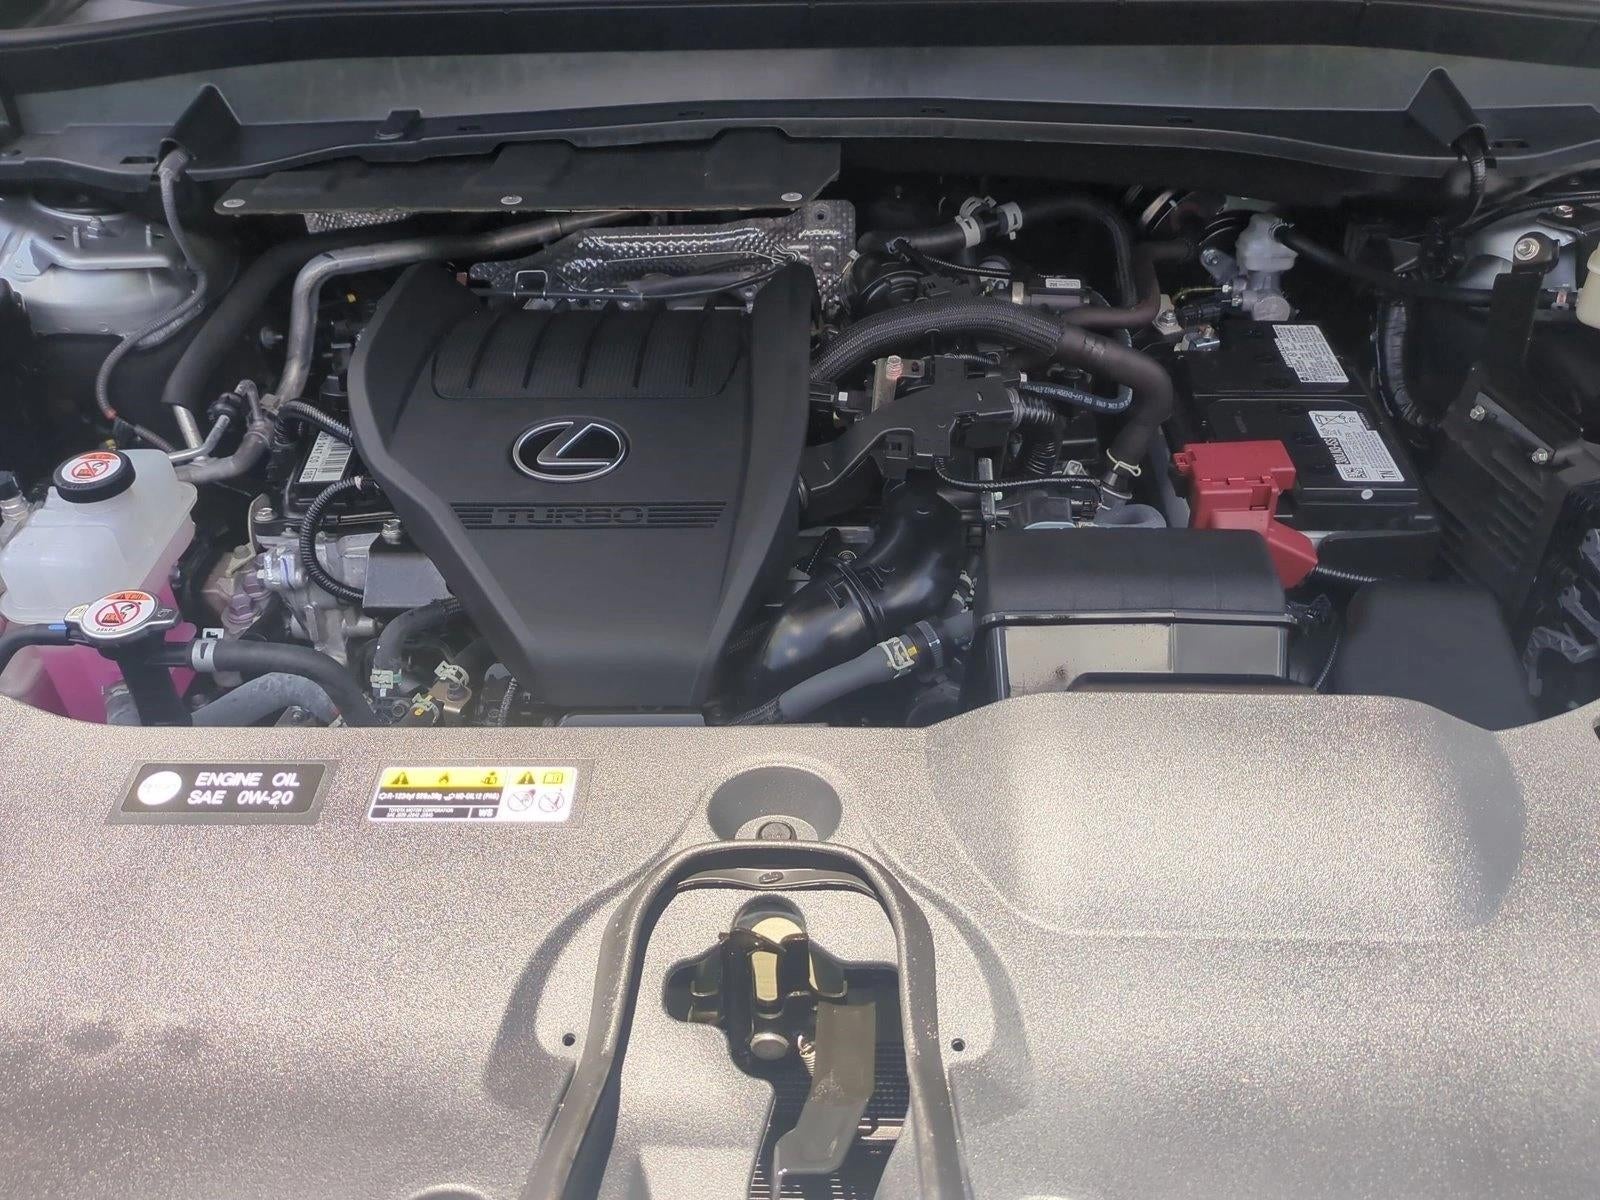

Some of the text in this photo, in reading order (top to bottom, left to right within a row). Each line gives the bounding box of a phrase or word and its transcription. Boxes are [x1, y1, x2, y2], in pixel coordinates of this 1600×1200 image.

[497, 507, 645, 524] TURBO
[194, 771, 300, 787] ENGINE OIL
[187, 790, 295, 805] SAE 0W-20
